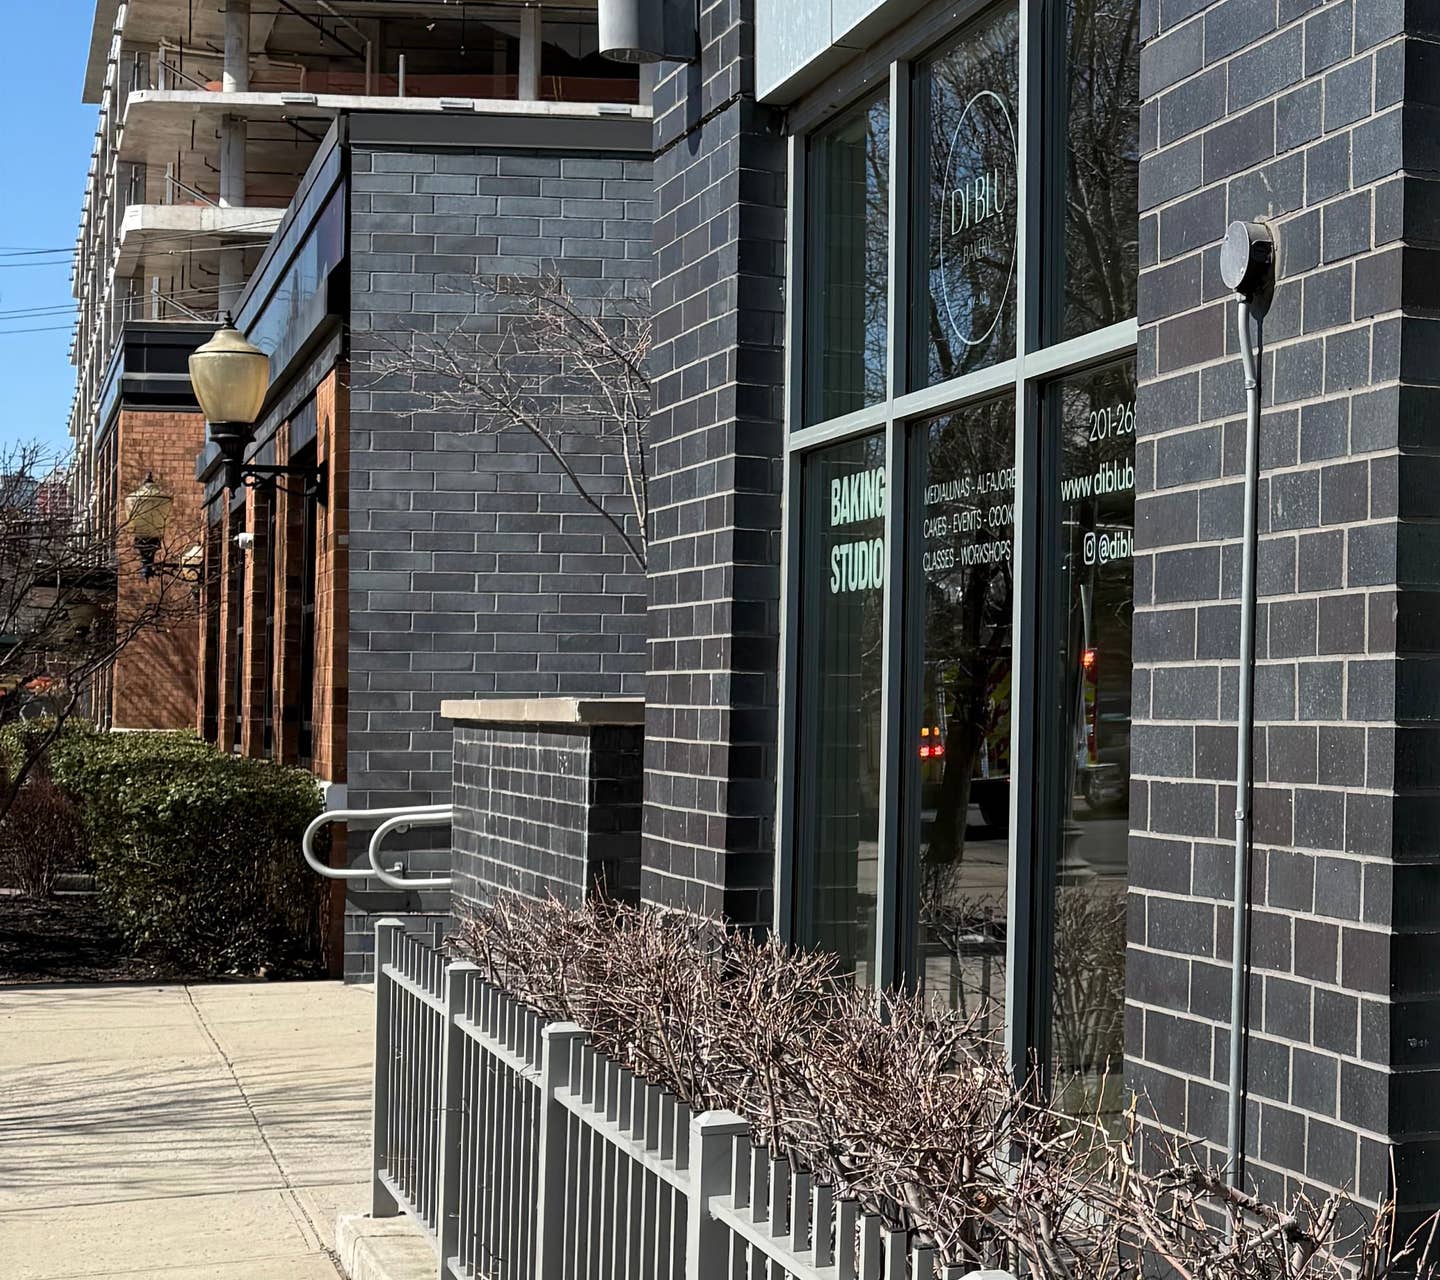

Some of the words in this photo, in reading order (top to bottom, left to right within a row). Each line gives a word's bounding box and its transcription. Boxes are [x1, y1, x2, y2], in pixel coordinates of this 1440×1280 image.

[951, 183, 969, 236] DI
[975, 163, 1007, 224] BLU
[1089, 401, 1137, 442] 201-26
[830, 466, 886, 527] BAKING
[924, 477, 970, 505] MEDIALUNAS
[923, 516, 947, 538] CAKES
[953, 509, 982, 533] EVENTS
[830, 537, 884, 594] STUDIO
[923, 548, 954, 572] CLASSES
[960, 540, 1011, 566] WORKSHOPS
